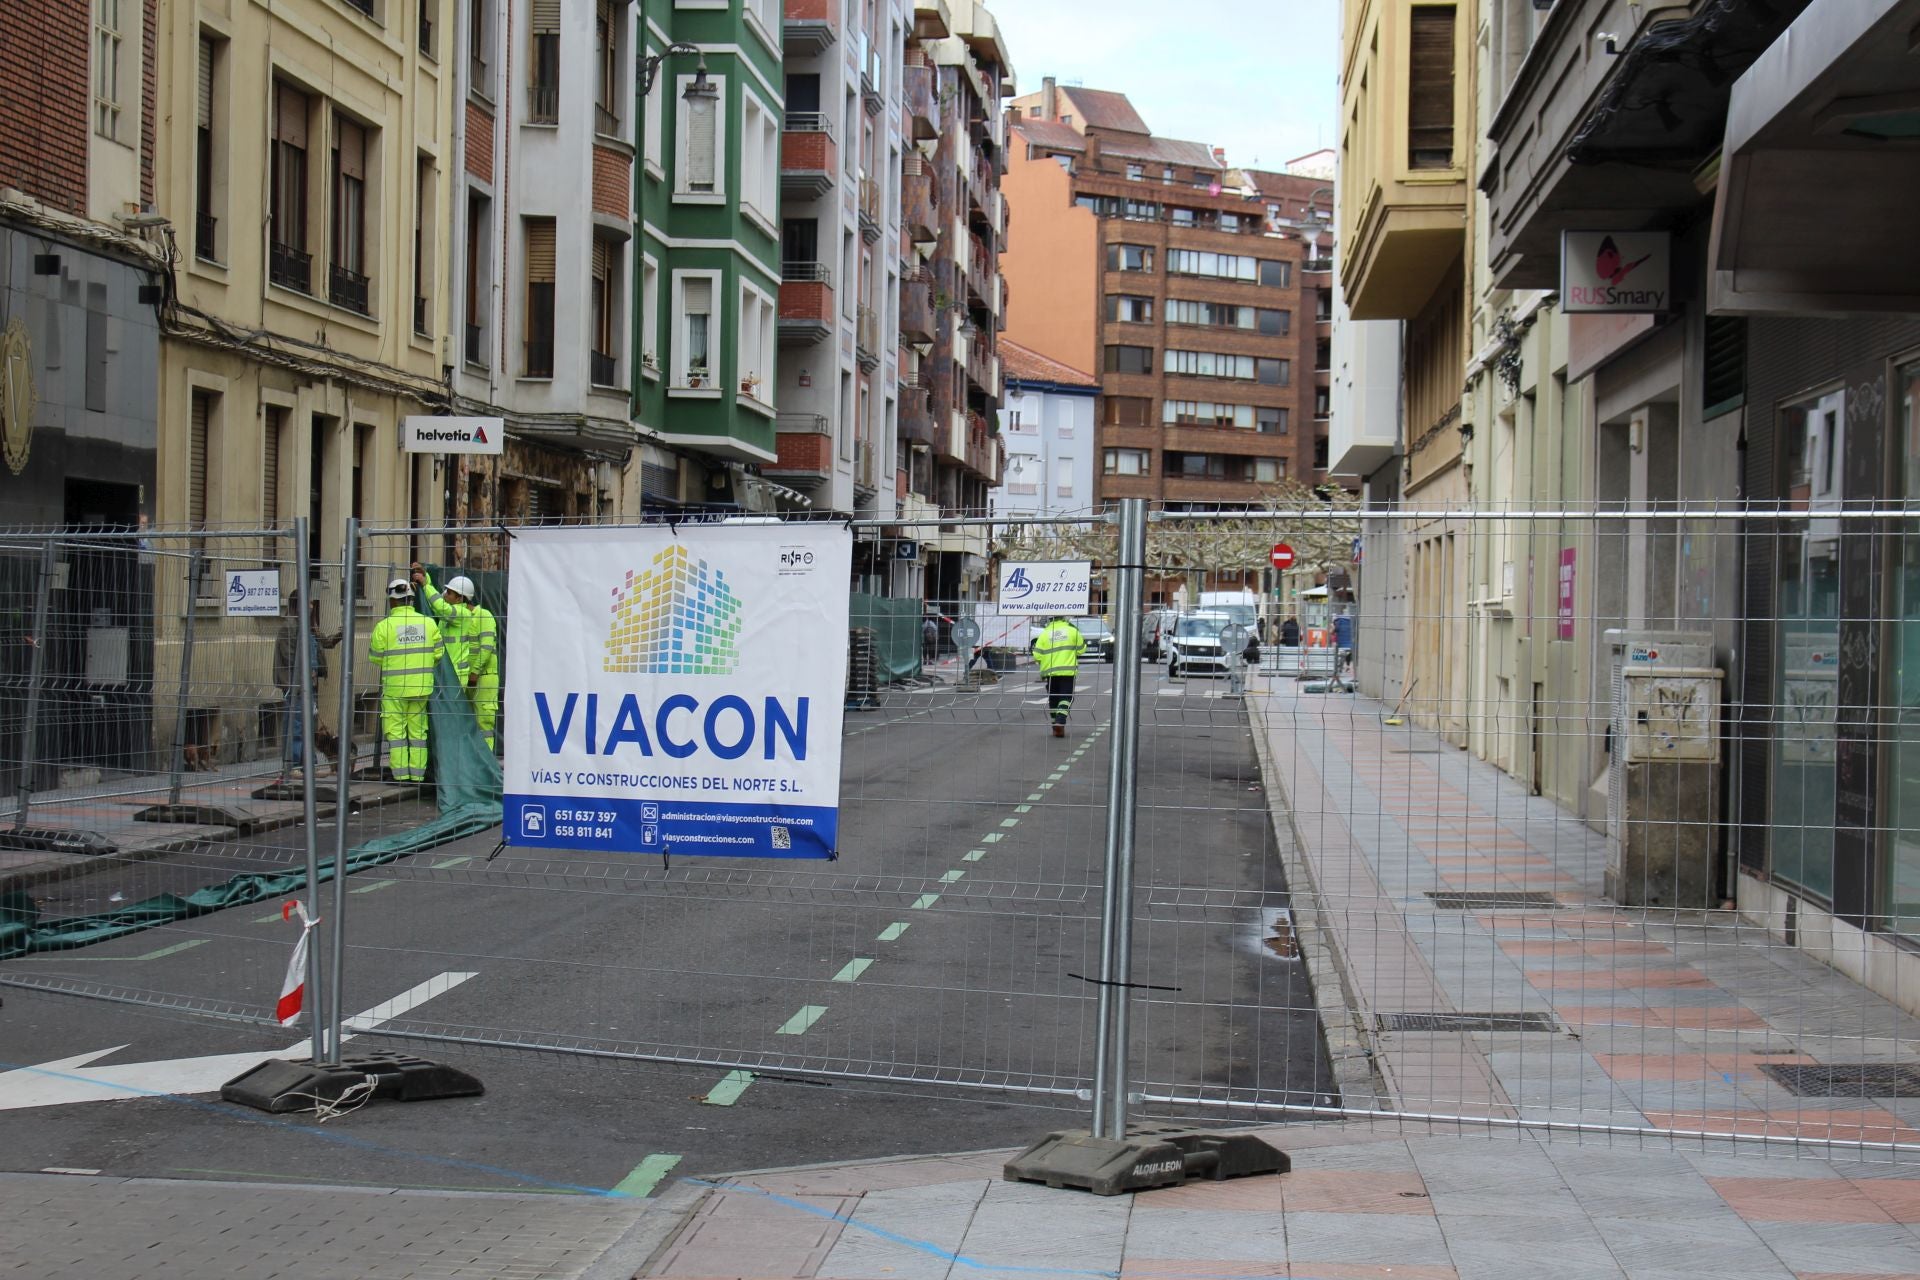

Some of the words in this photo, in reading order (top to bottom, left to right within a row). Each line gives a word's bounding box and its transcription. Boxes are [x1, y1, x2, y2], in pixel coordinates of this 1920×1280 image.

[1570, 286, 1664, 308] RUSSmary
[416, 428, 470, 441] helvetia
[1036, 582, 1051, 592] 987
[1053, 582, 1064, 592] 27
[1065, 582, 1075, 592] 62
[1077, 582, 1087, 592] 95
[1002, 602, 1085, 611] www.alquileon.com
[534, 692, 809, 760] VIACON
[531, 768, 560, 784] VÍAS
[565, 772, 572, 784] Y
[577, 772, 697, 789] CONSTRUCCIONES
[702, 777, 728, 790] DEL
[733, 778, 776, 791] NORTE
[780, 779, 803, 792] S.L.
[555, 810, 572, 820] 651
[575, 811, 594, 821] 637
[597, 812, 617, 822] 397
[661, 812, 813, 826] administracion@viasyconstrucciones.com
[555, 826, 574, 836] 658
[577, 827, 592, 838] 811
[595, 828, 612, 838] 841
[662, 833, 755, 844] viasyconstrucciones.com
[1132, 1159, 1182, 1176] ALQUI-LEON
